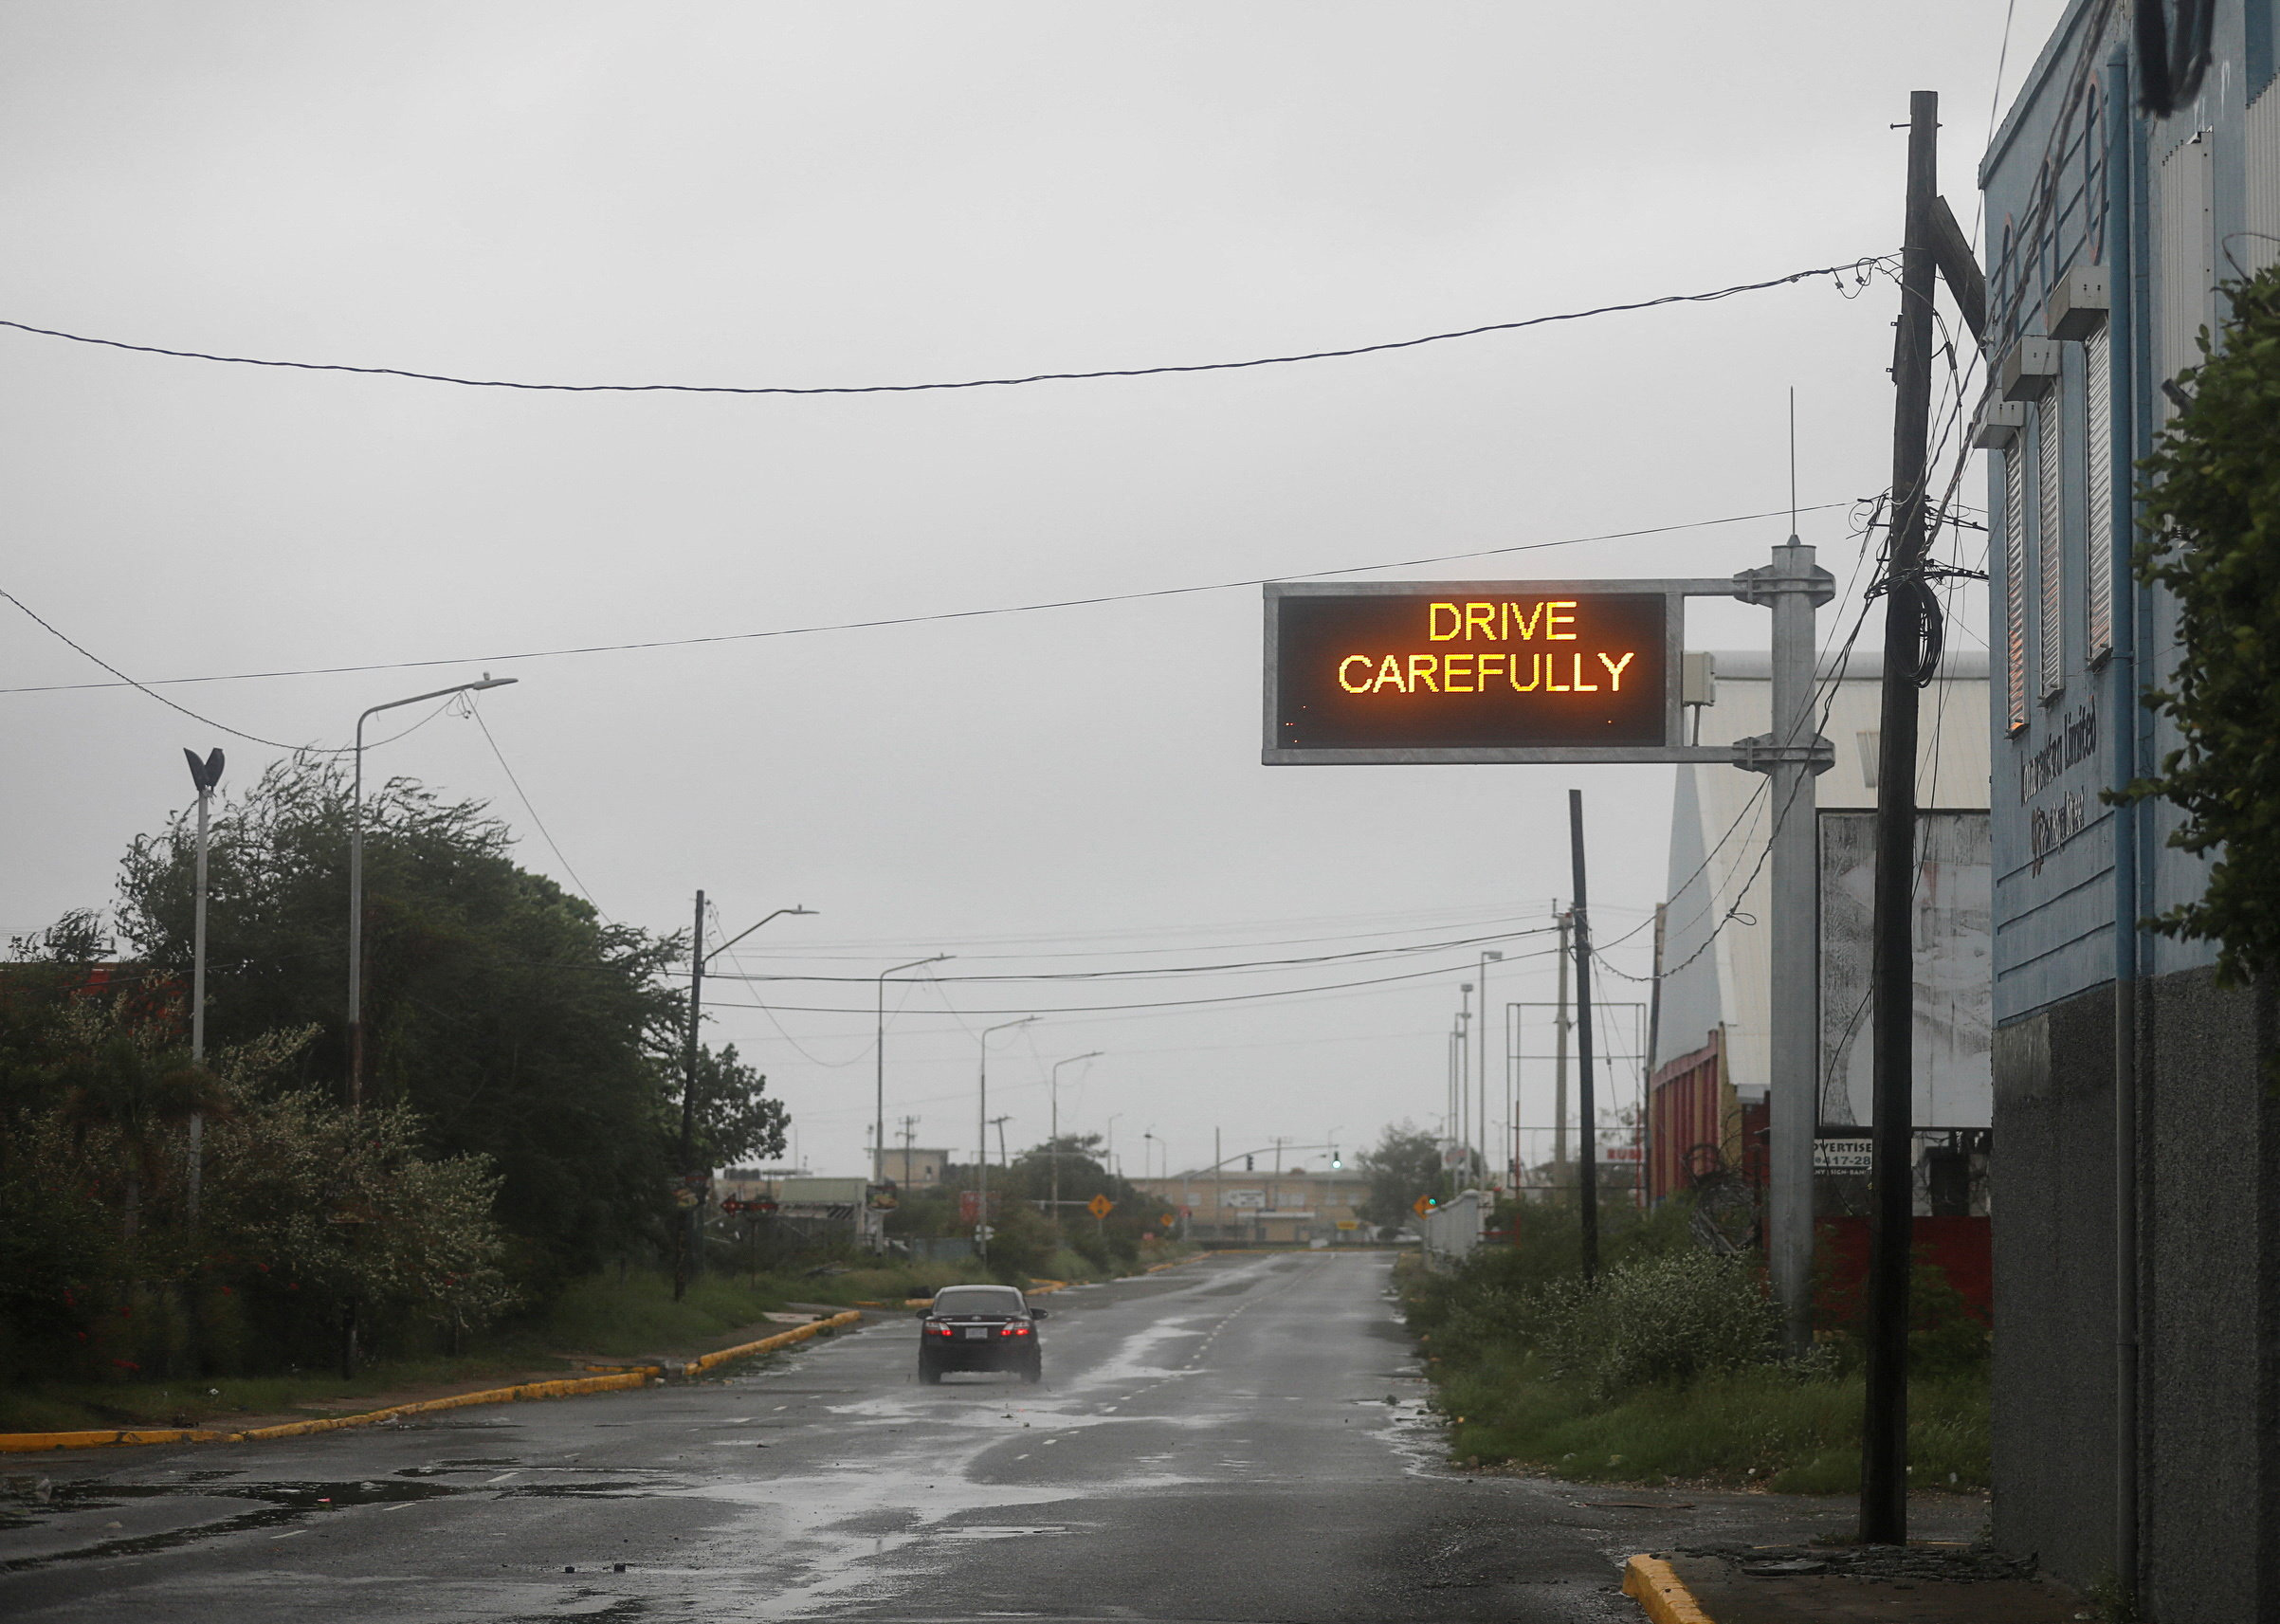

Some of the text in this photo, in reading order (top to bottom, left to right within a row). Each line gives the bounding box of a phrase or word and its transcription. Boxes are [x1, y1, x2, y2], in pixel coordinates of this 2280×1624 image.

[1430, 601, 1578, 641] DRIVE
[1339, 652, 1634, 694] CAREFULLY
[2064, 695, 2097, 771] Limited
